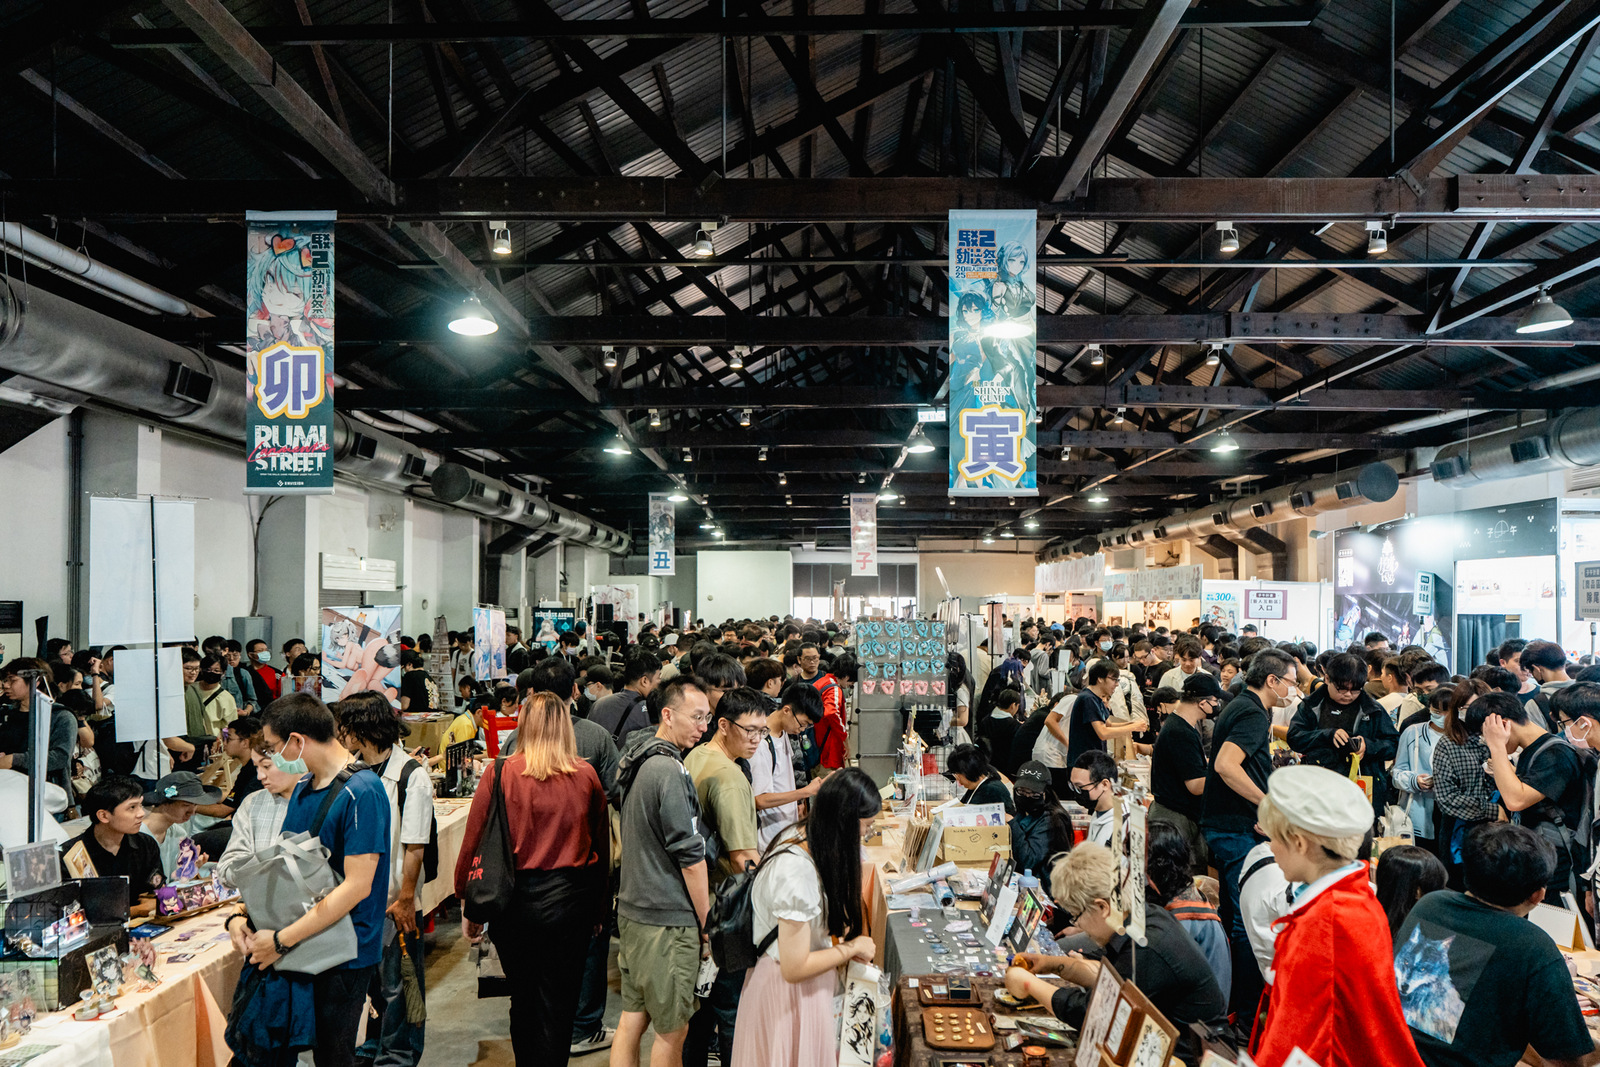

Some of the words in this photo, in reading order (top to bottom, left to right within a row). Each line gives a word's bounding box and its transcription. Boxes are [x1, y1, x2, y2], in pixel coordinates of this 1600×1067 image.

[263, 350, 317, 411] 卯
[255, 425, 327, 449] RUMI
[965, 411, 1020, 474] 寅
[255, 452, 326, 472] STREET
[653, 551, 671, 569] 丑
[856, 552, 873, 570] 子
